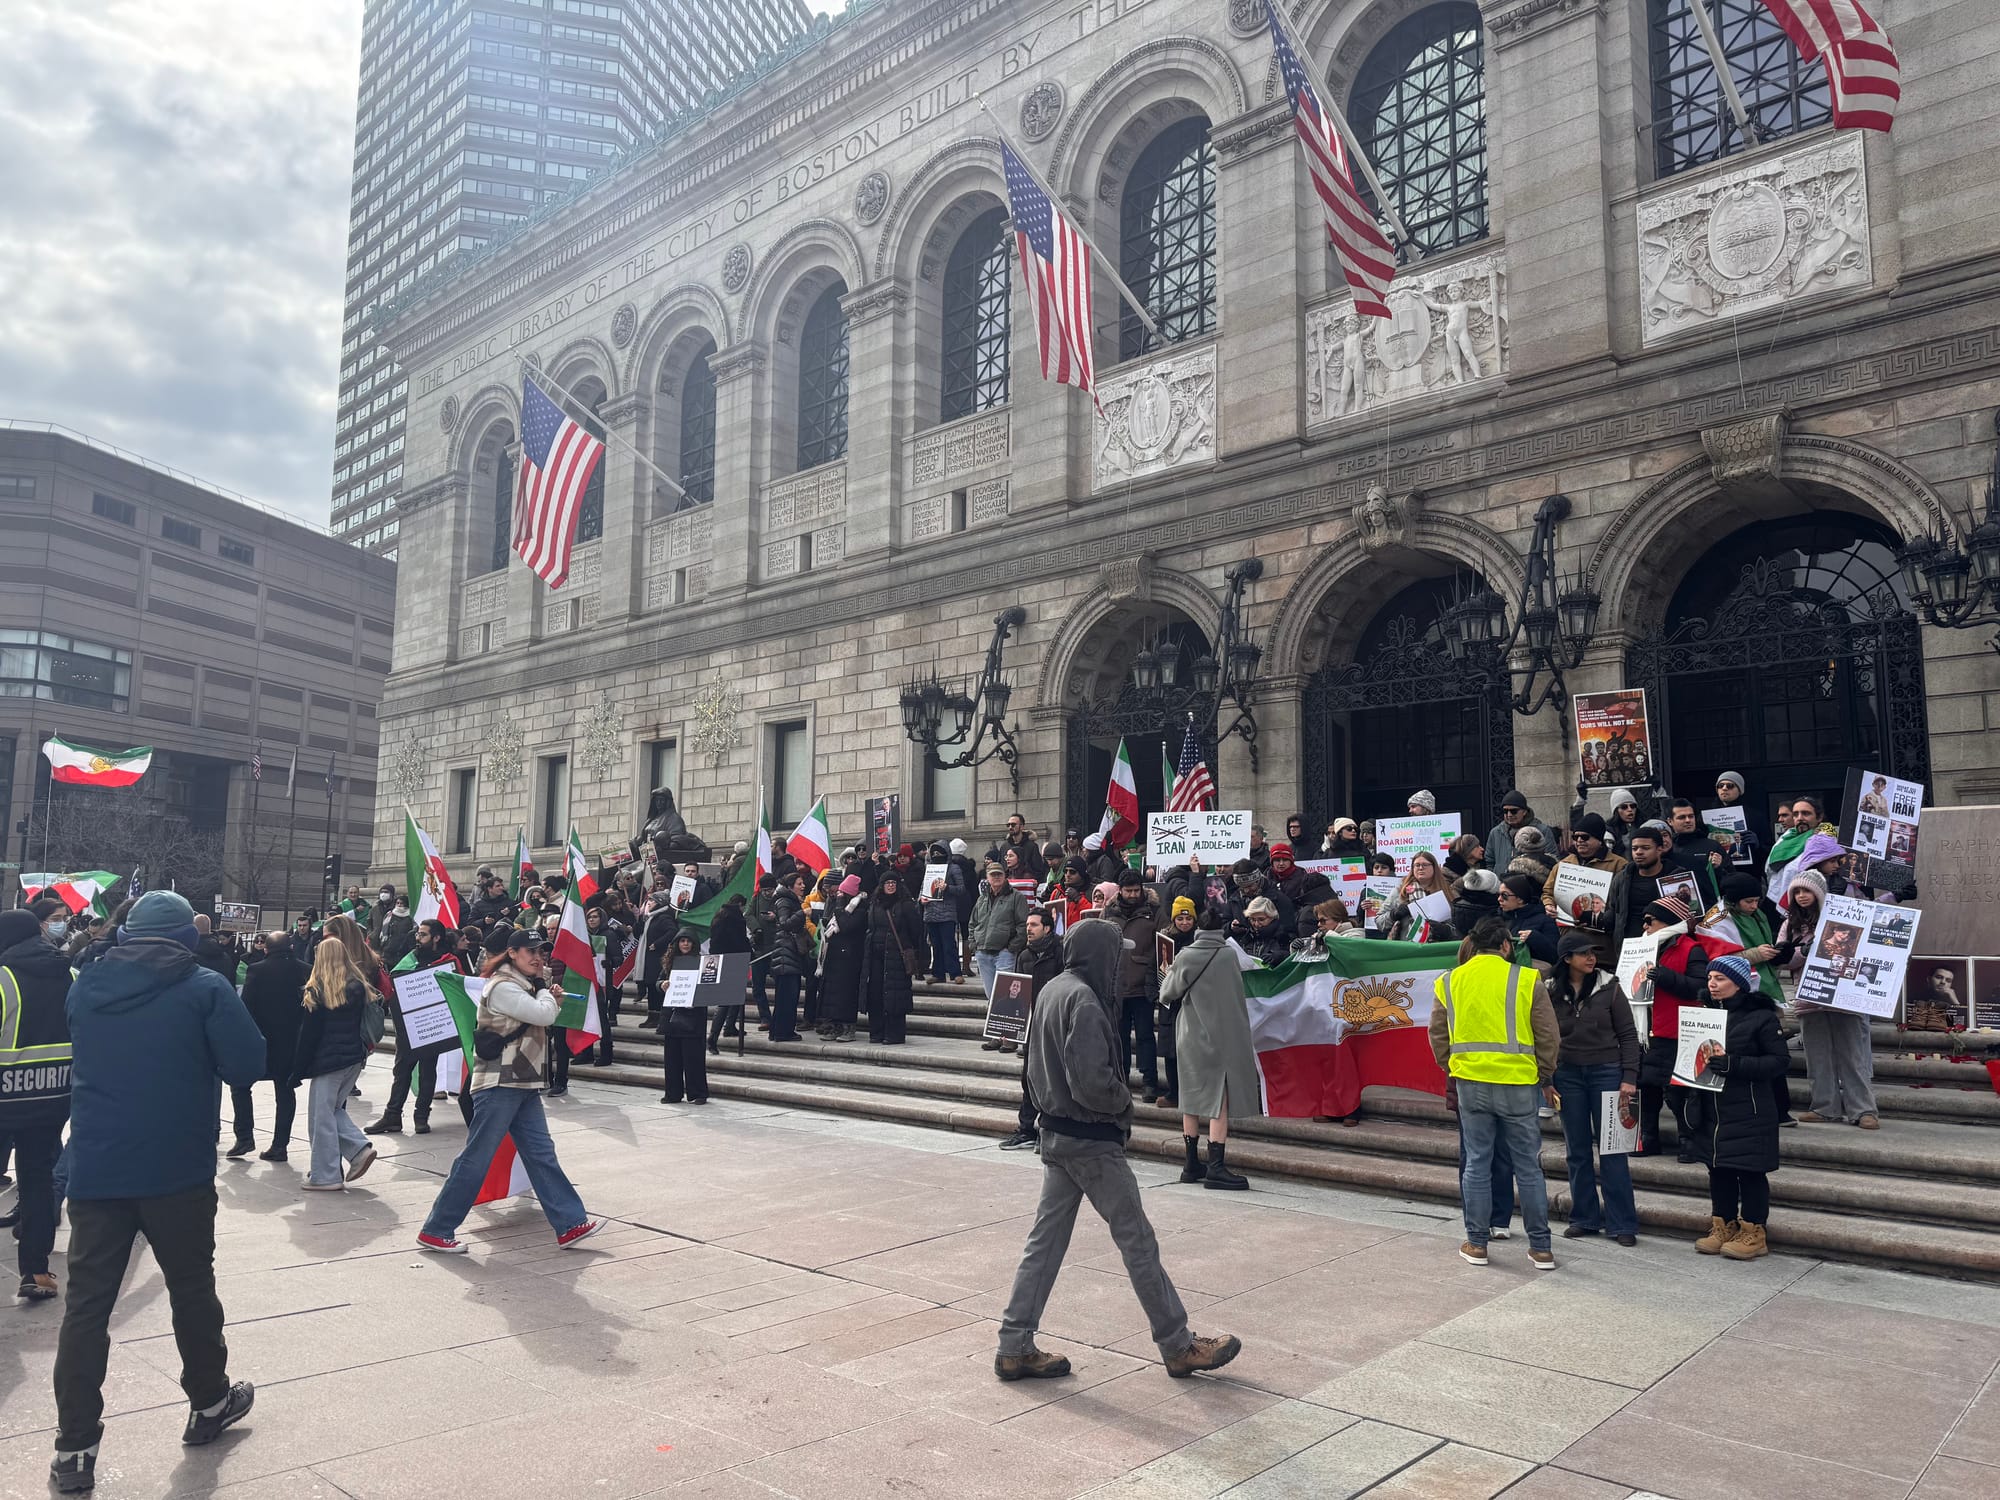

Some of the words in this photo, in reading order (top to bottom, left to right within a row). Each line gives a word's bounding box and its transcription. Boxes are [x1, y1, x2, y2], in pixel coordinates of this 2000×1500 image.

[420, 367, 444, 394] THE
[453, 337, 497, 376] PUBLIC
[509, 294, 574, 346] LIBRARY
[584, 275, 608, 304] OF
[621, 248, 656, 284] THE
[668, 214, 718, 258] CITY
[733, 189, 763, 223] OF
[777, 122, 880, 202] BOSTON
[900, 67, 979, 134] BUILT
[1000, 31, 1042, 80] BY
[1893, 793, 1917, 806] FREE
[1891, 802, 1916, 818] IRAN
[1153, 817, 1160, 825] A
[1163, 814, 1186, 824] FREE
[1206, 814, 1243, 825] PEACE
[1390, 820, 1442, 830] COURAGEOUS
[1193, 840, 1246, 850] MIDDLE-EAST
[1378, 837, 1414, 847] ROARING
[1156, 841, 1186, 855] IRAN
[1305, 864, 1339, 874] VALENTINE
[1560, 873, 1577, 882] REZA
[1578, 877, 1607, 888] PAHLAVI
[1697, 1022, 1722, 1031] PAHLAVI
